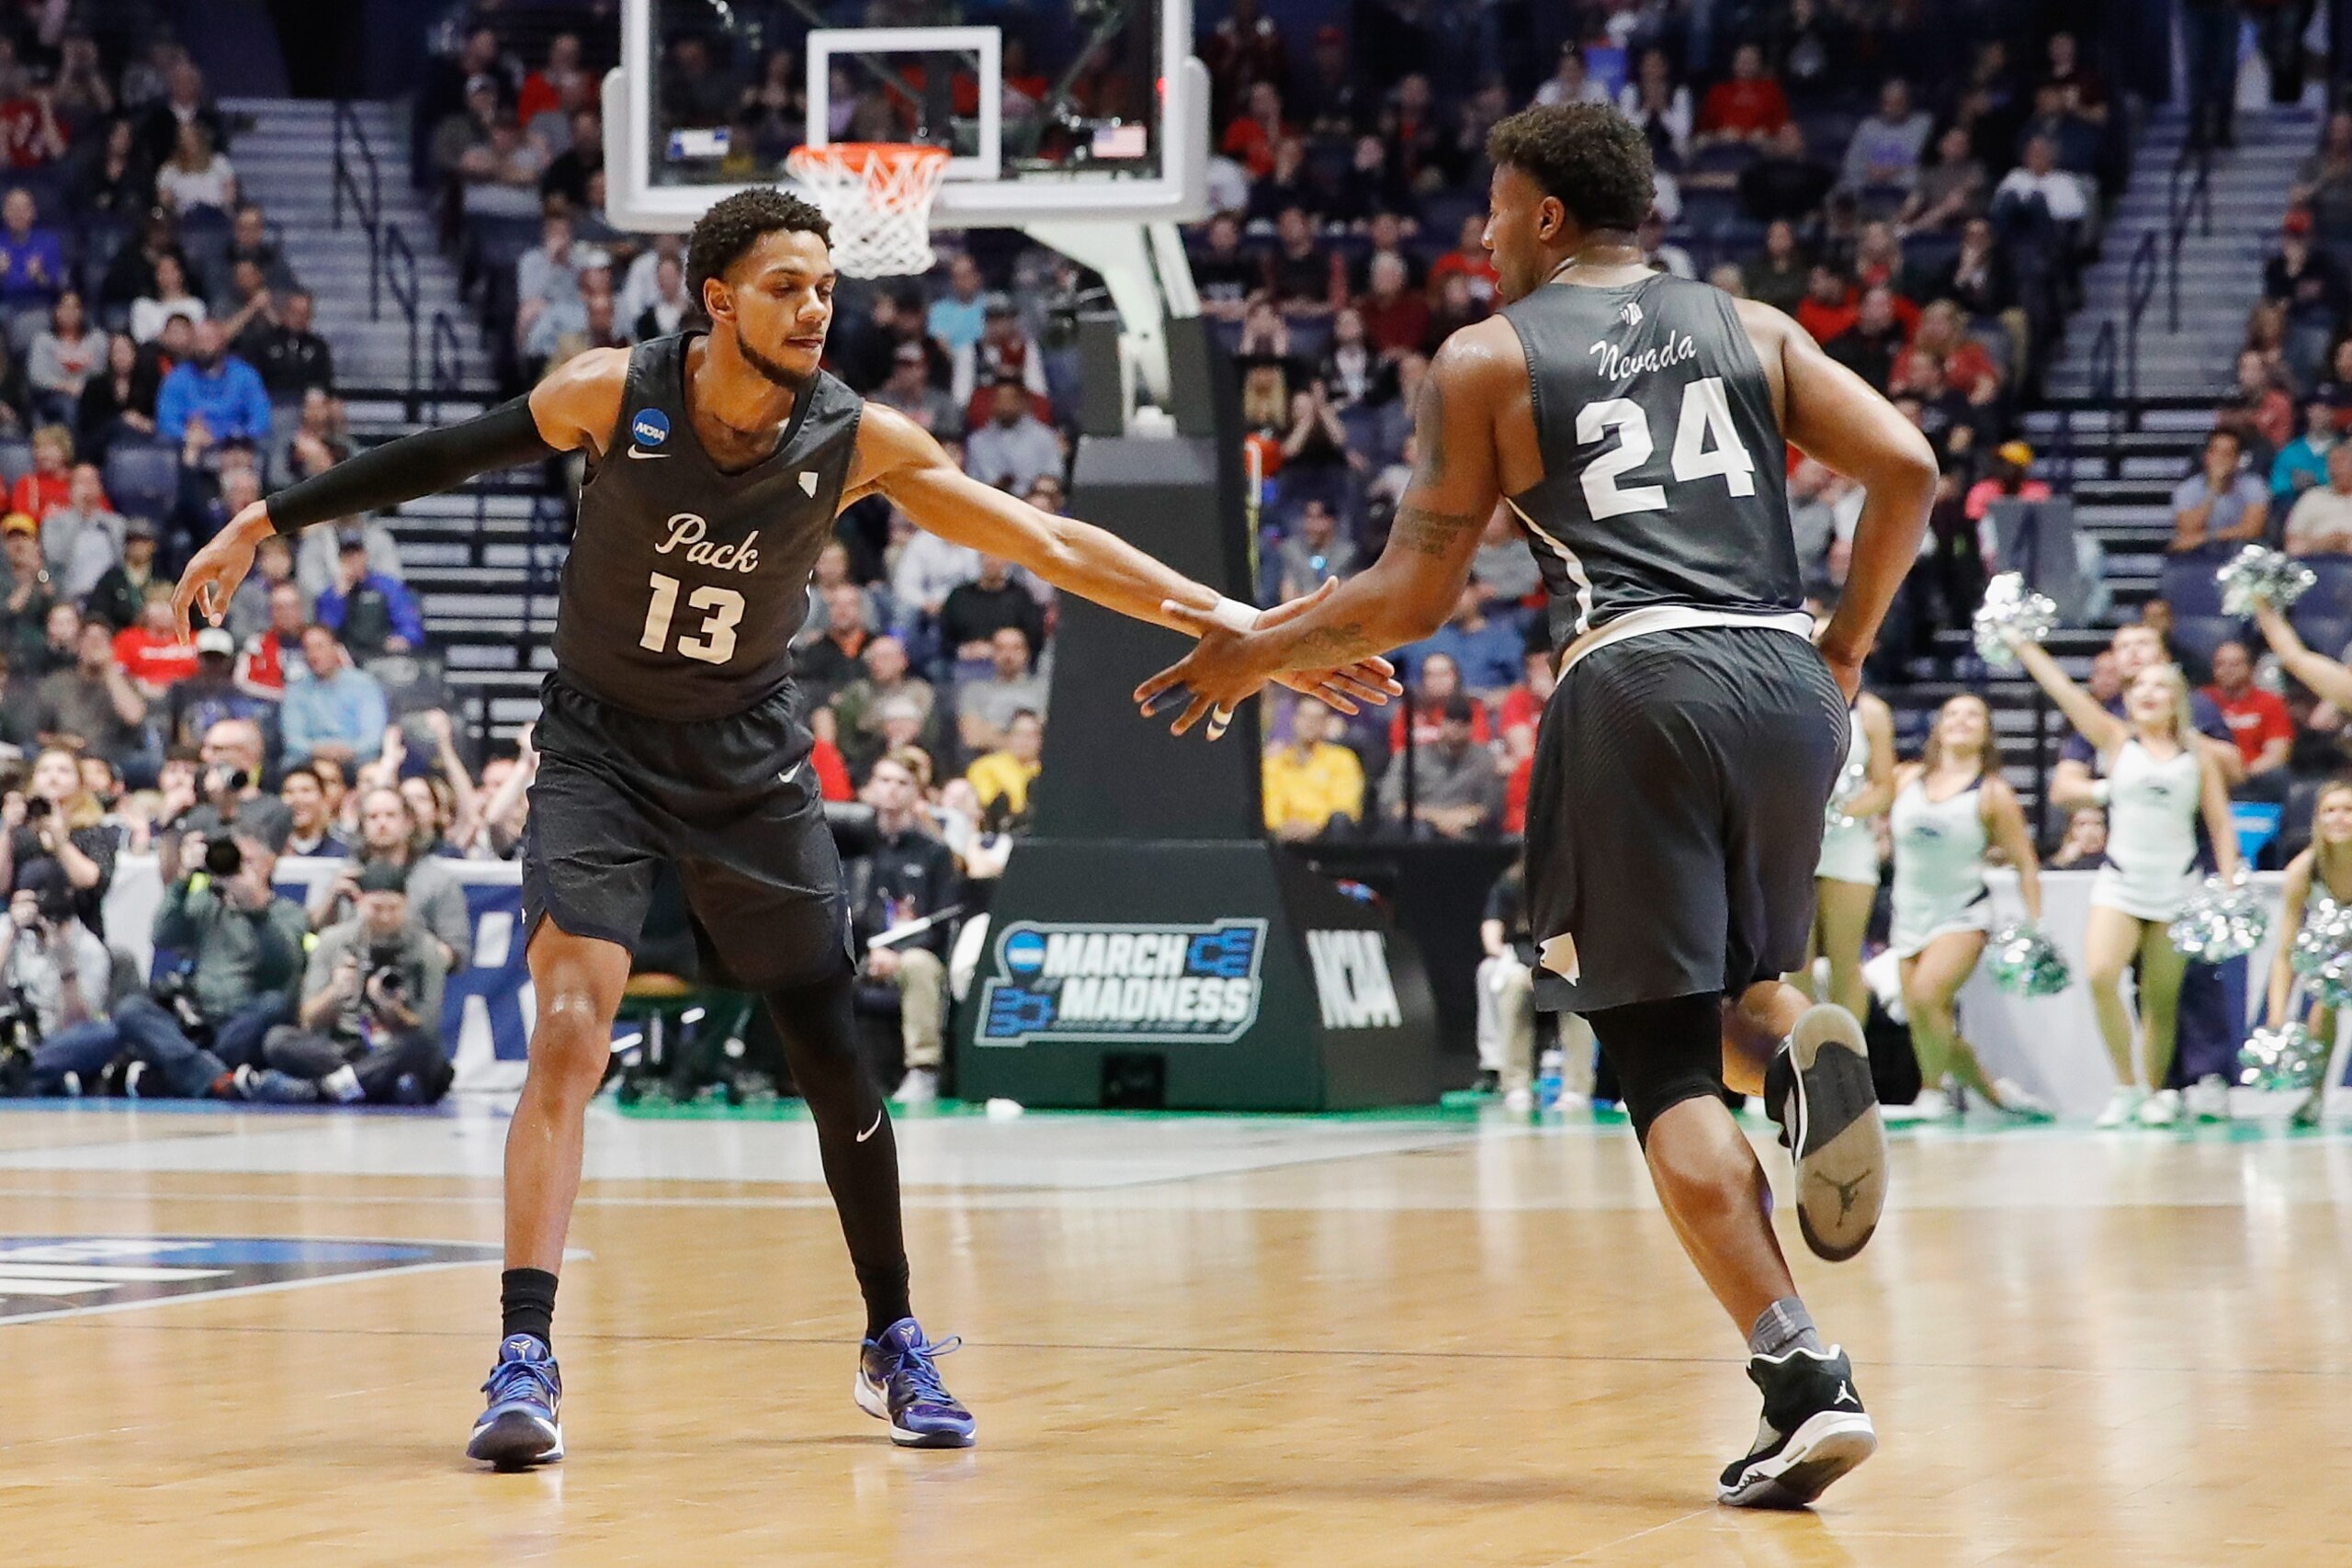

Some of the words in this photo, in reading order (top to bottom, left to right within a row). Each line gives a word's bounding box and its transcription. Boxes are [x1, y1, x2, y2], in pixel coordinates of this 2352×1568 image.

[1589, 330, 1697, 382] Nevada
[635, 422, 666, 442] NCAA
[1575, 377, 1756, 522] 24
[654, 512, 759, 574] Pack
[639, 571, 745, 665] 13
[1042, 931, 1191, 977] MARCH
[1058, 976, 1252, 1022] MADNESS
